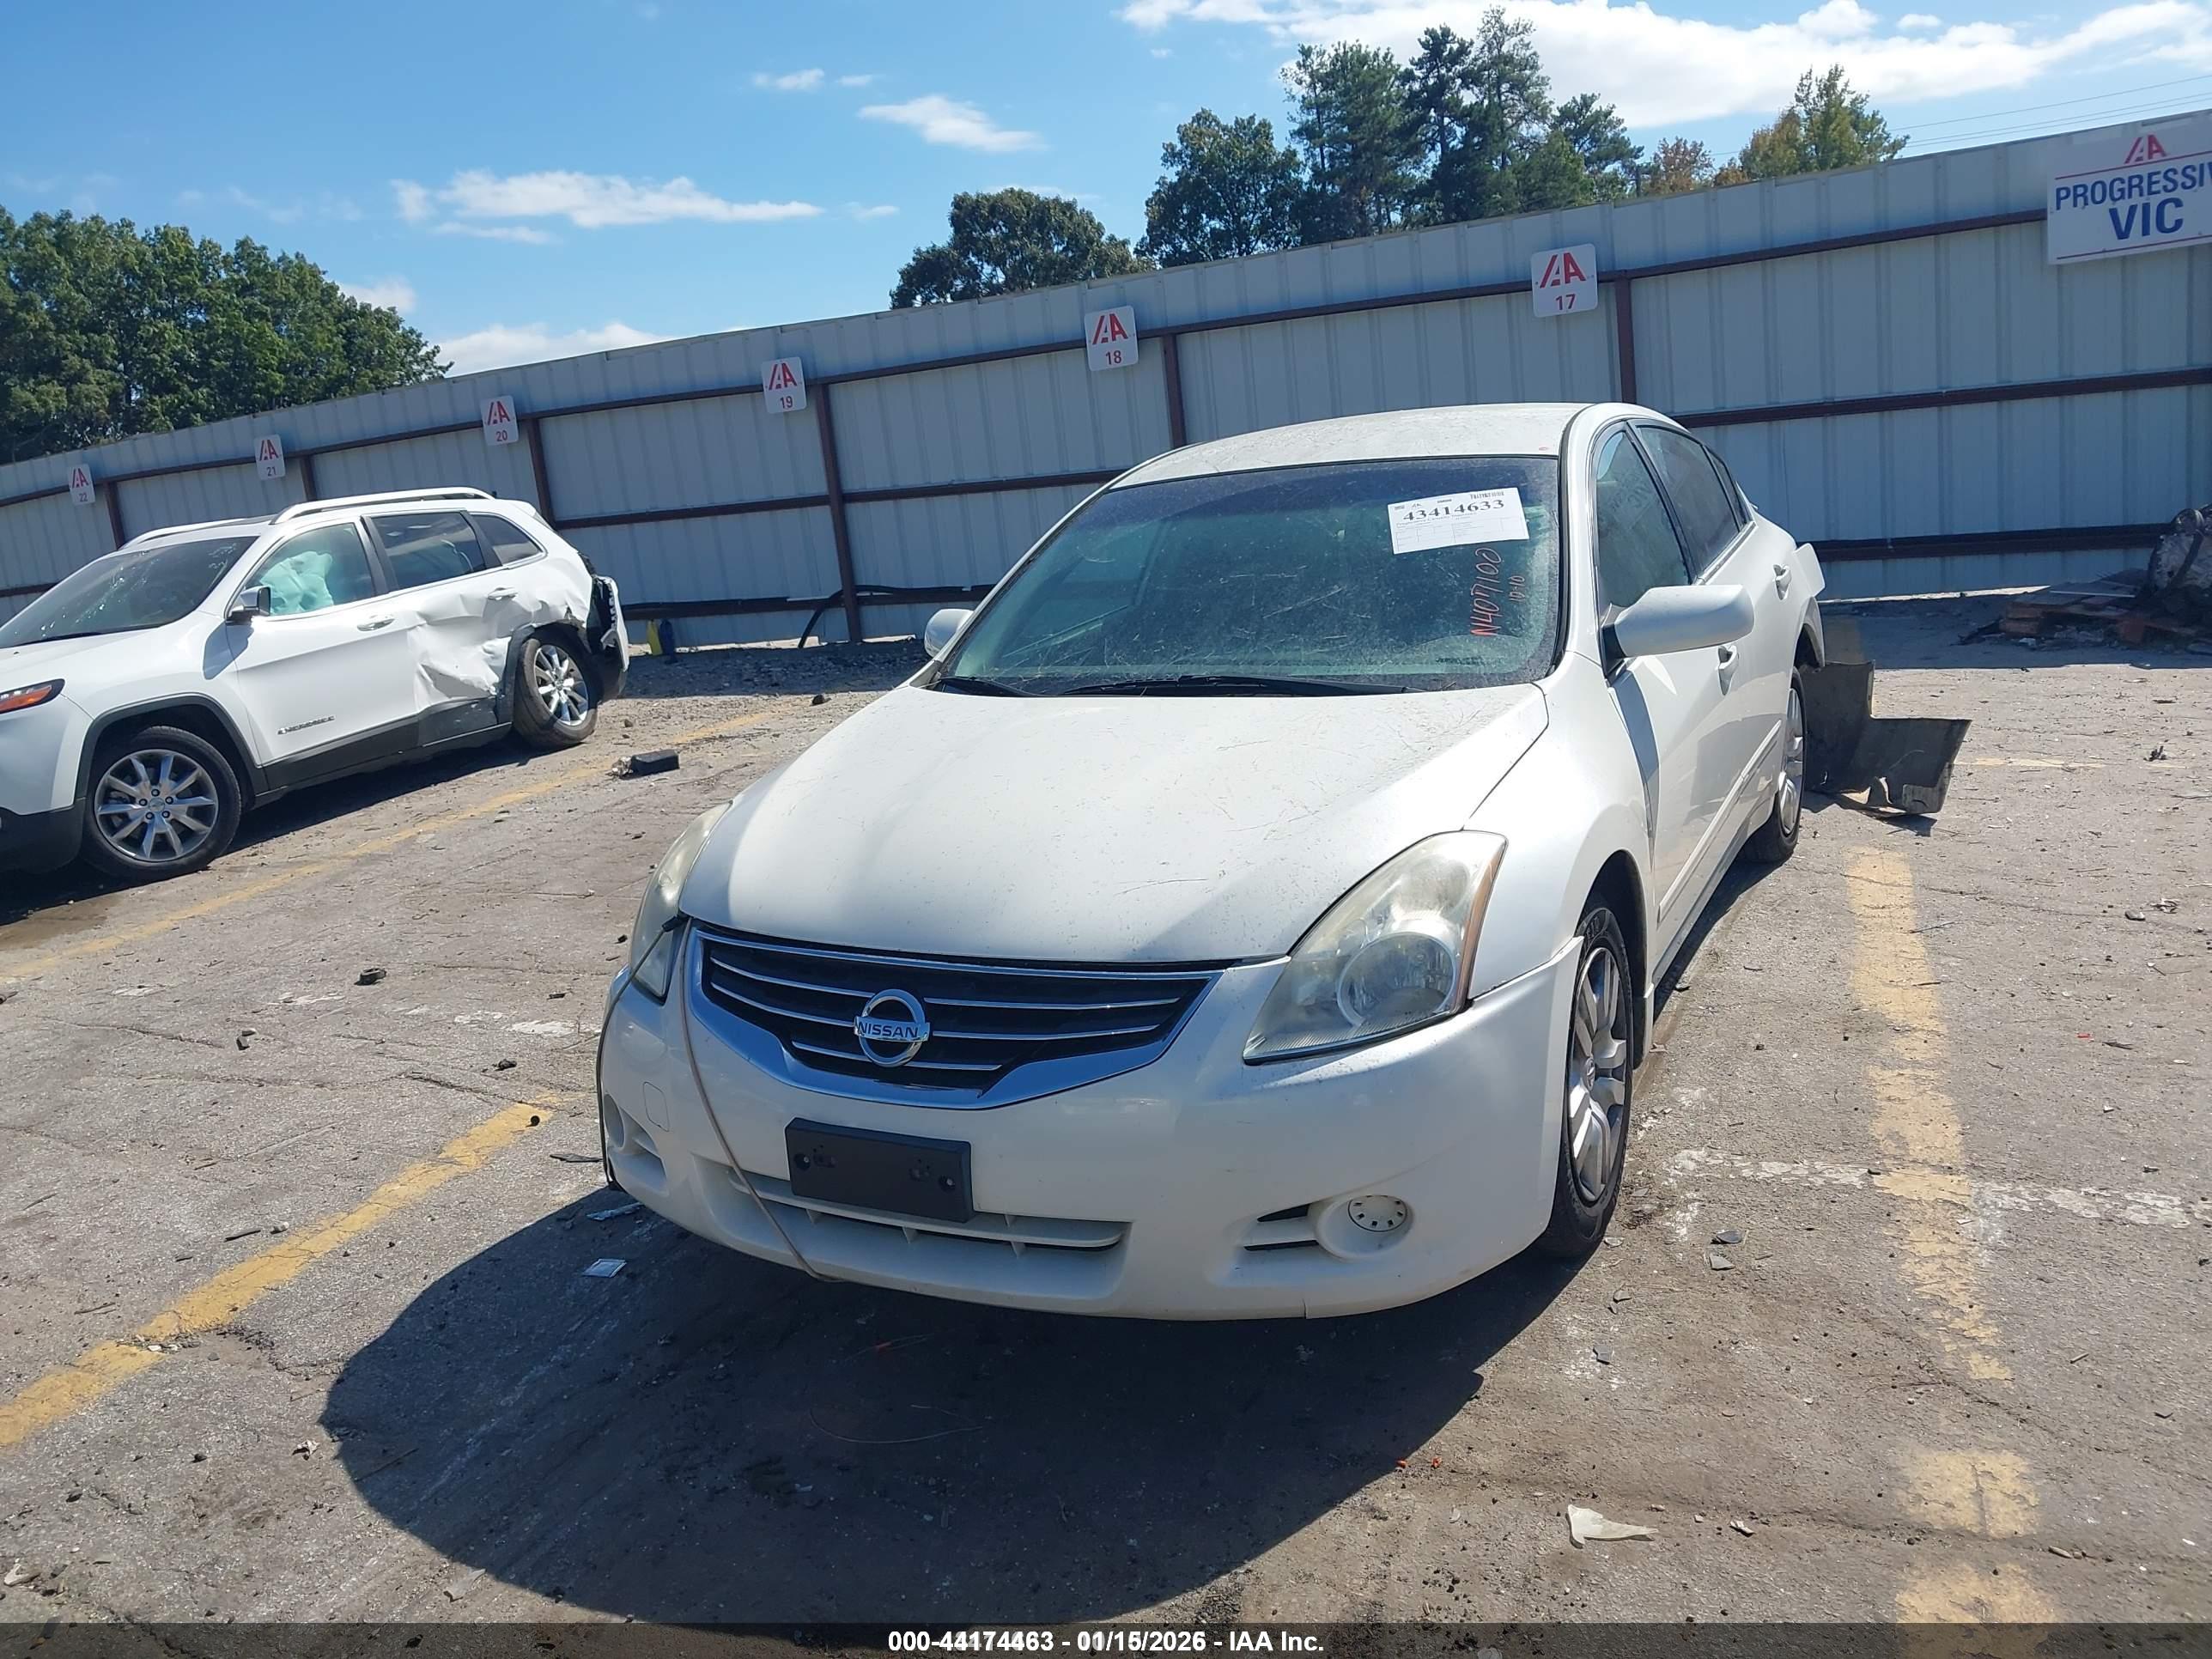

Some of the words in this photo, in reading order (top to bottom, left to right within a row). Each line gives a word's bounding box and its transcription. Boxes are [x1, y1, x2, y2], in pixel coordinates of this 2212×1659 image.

[2055, 161, 2212, 211] PROGRESSI
[2108, 197, 2184, 240] VIC
[1555, 293, 1576, 311] 17
[1105, 349, 1122, 365] 18
[780, 395, 793, 409] 19
[495, 429, 508, 442] 20
[266, 466, 276, 477] 21
[1402, 499, 1505, 521] 43414633
[858, 1021, 919, 1038] NISSAN
